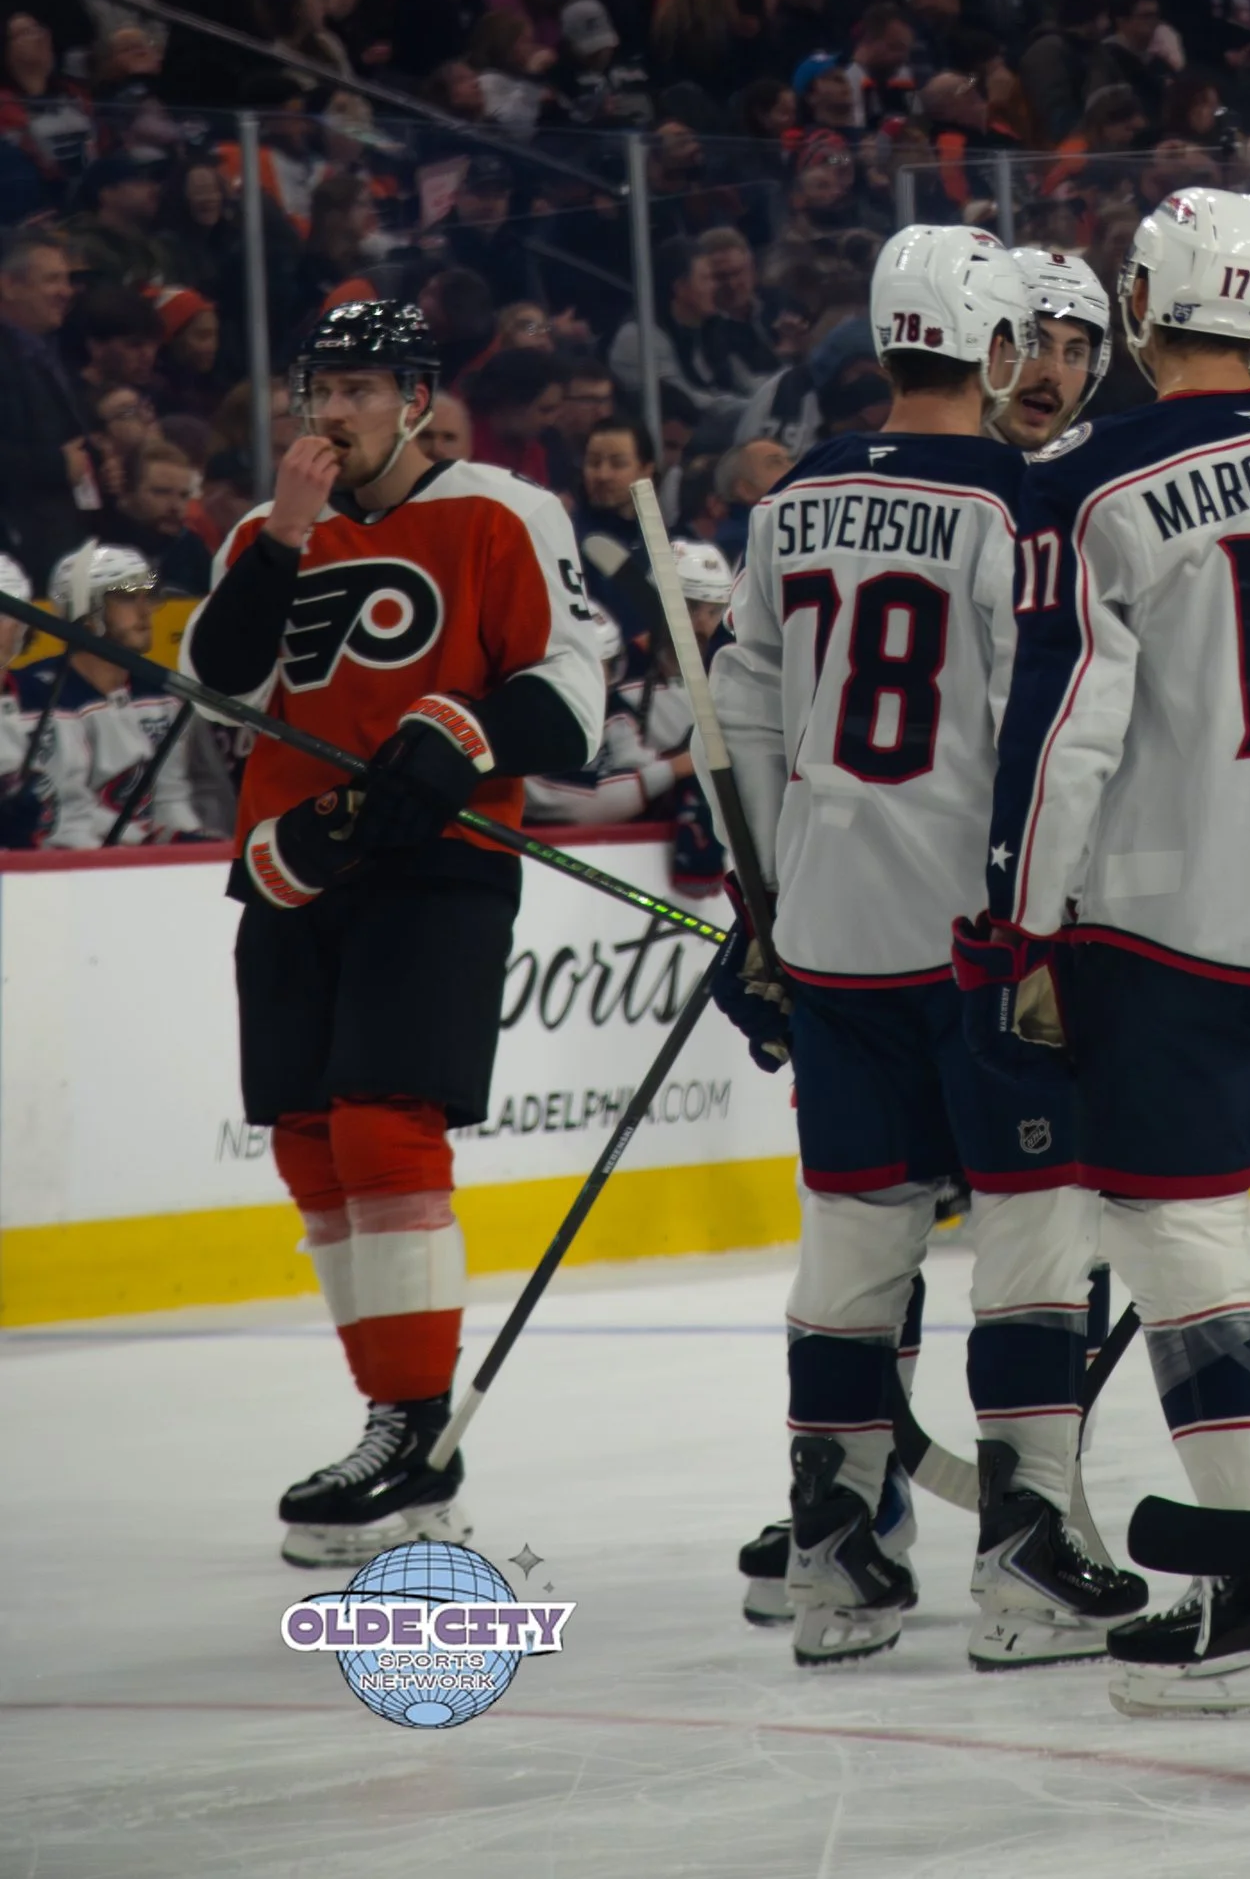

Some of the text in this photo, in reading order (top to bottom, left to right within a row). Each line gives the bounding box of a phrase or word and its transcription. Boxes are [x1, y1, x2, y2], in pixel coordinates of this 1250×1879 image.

[892, 312, 922, 343] 78
[778, 494, 961, 561] SEVERSON
[1013, 526, 1063, 615] 17
[781, 568, 950, 785] 78
